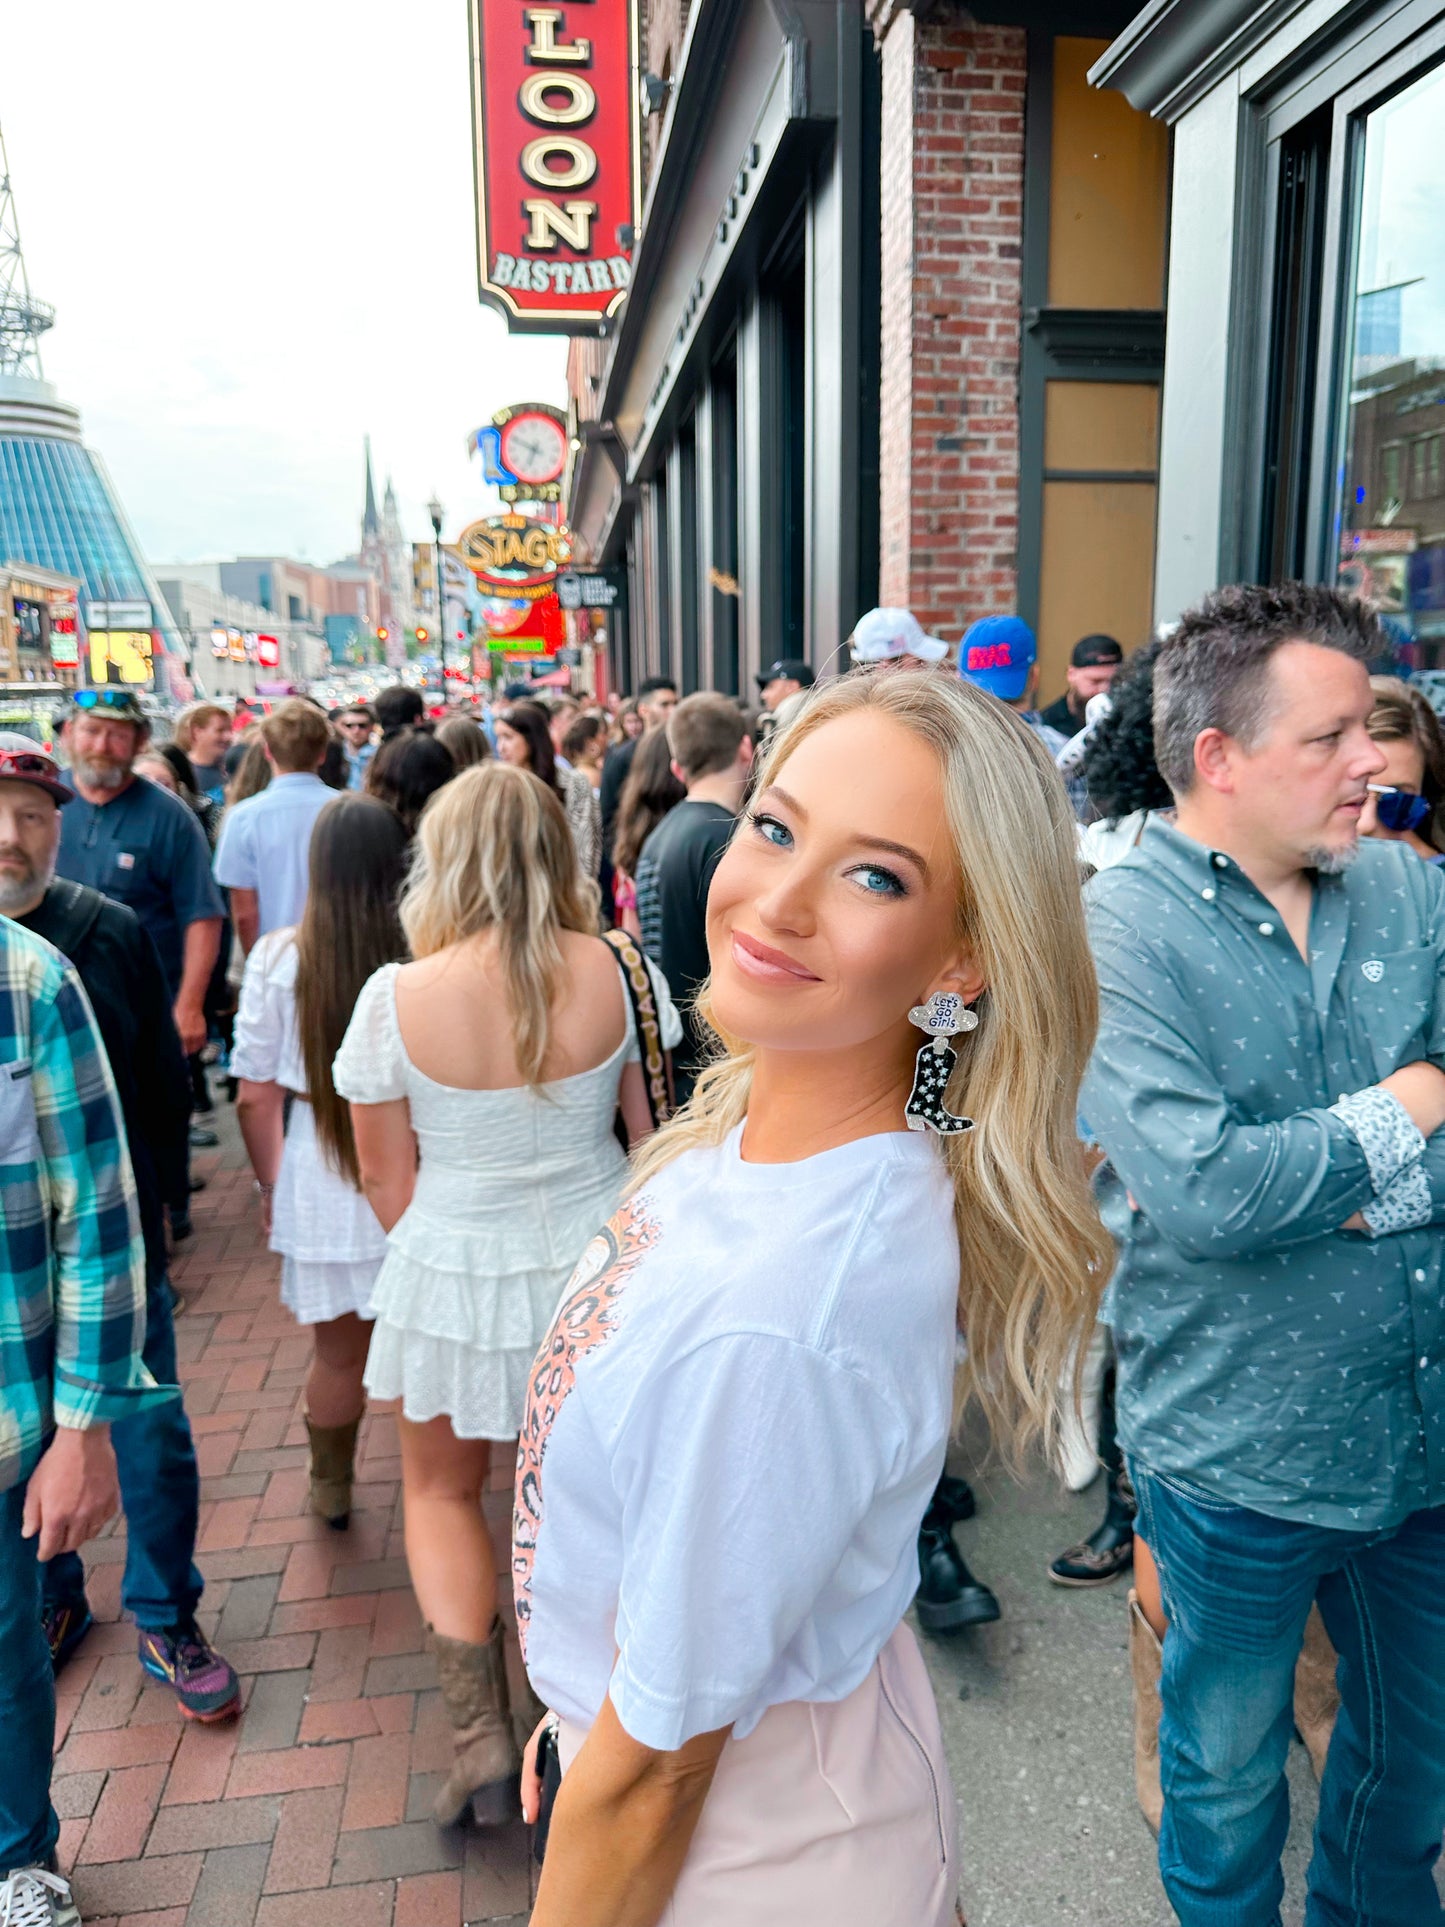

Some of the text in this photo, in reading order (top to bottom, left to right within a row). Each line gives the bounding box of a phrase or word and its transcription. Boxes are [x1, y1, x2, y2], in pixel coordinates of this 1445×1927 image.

[518, 0, 598, 252] LOON
[491, 252, 632, 295] BASTARD
[934, 996, 958, 1008] Let's
[936, 1007, 952, 1017] Go
[929, 1017, 956, 1028] Girls
